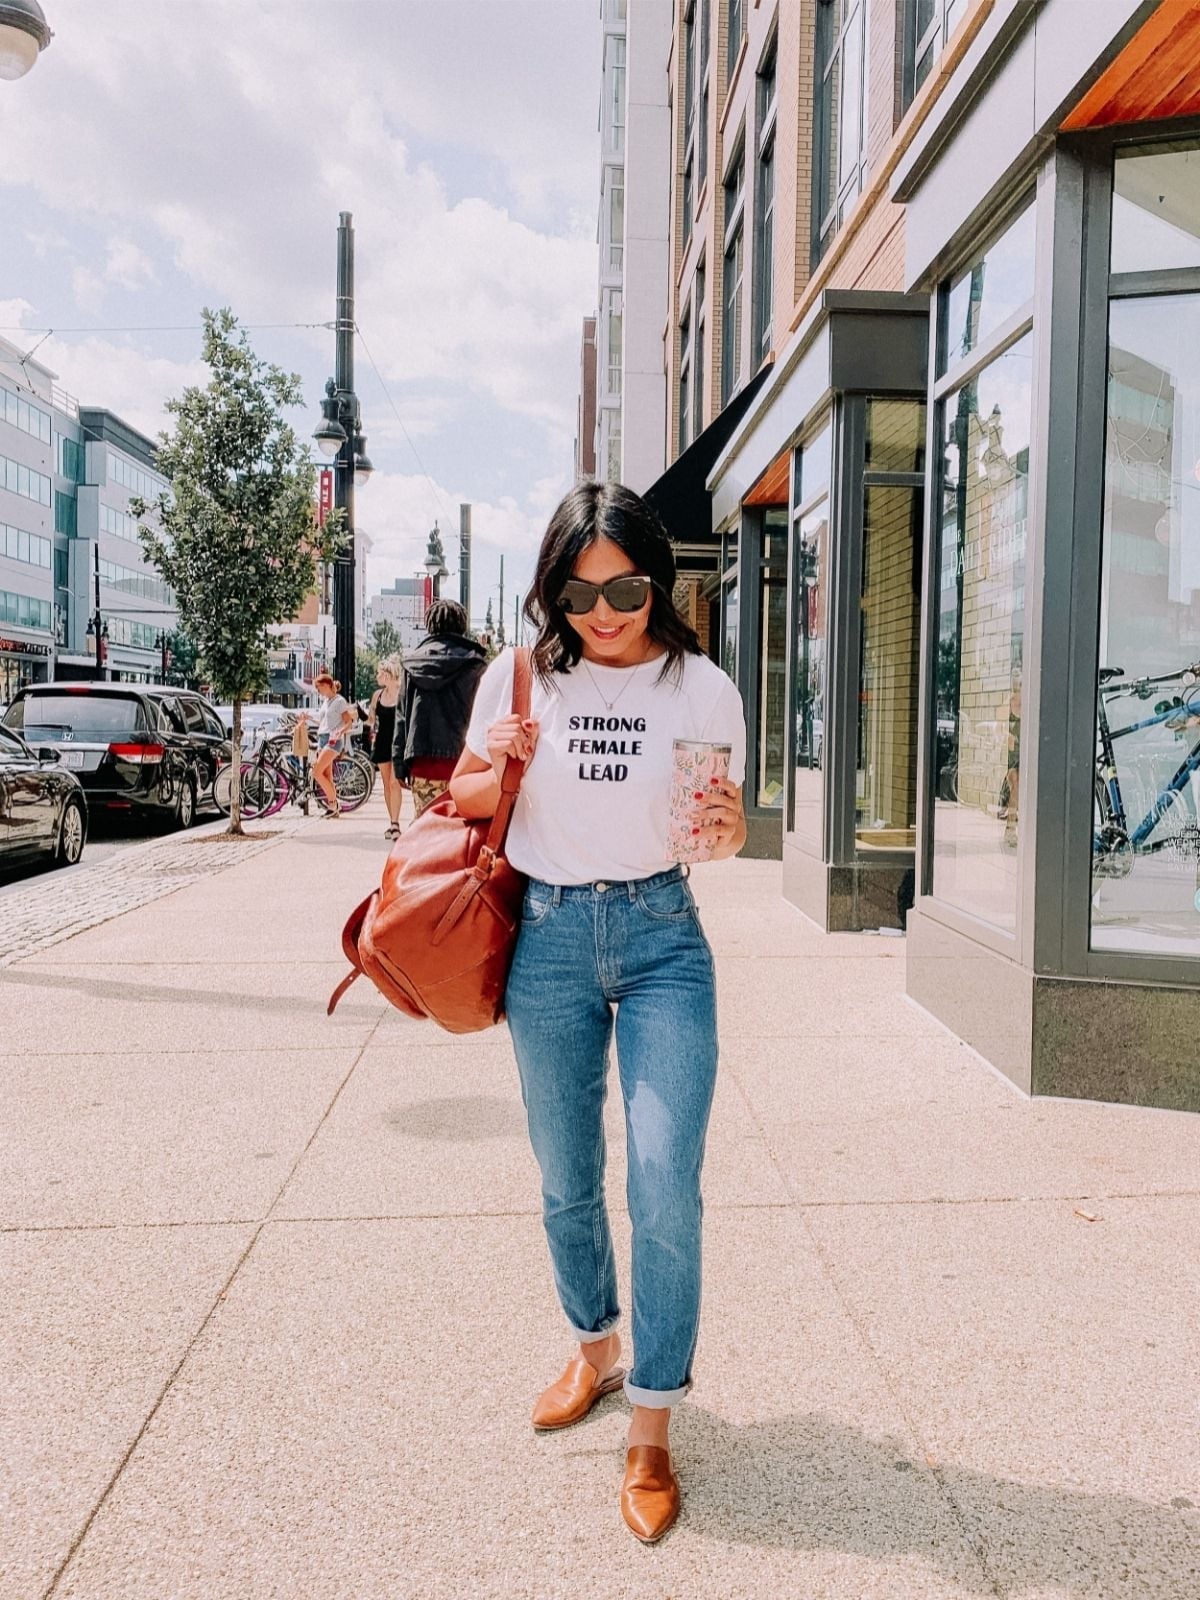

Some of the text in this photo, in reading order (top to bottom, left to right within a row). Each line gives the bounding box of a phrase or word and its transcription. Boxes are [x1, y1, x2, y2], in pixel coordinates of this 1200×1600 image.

[569, 716, 646, 732] STRONG
[568, 739, 642, 755] FEMALE
[579, 763, 628, 782] LEAD
[1169, 831, 1200, 839] TUESD
